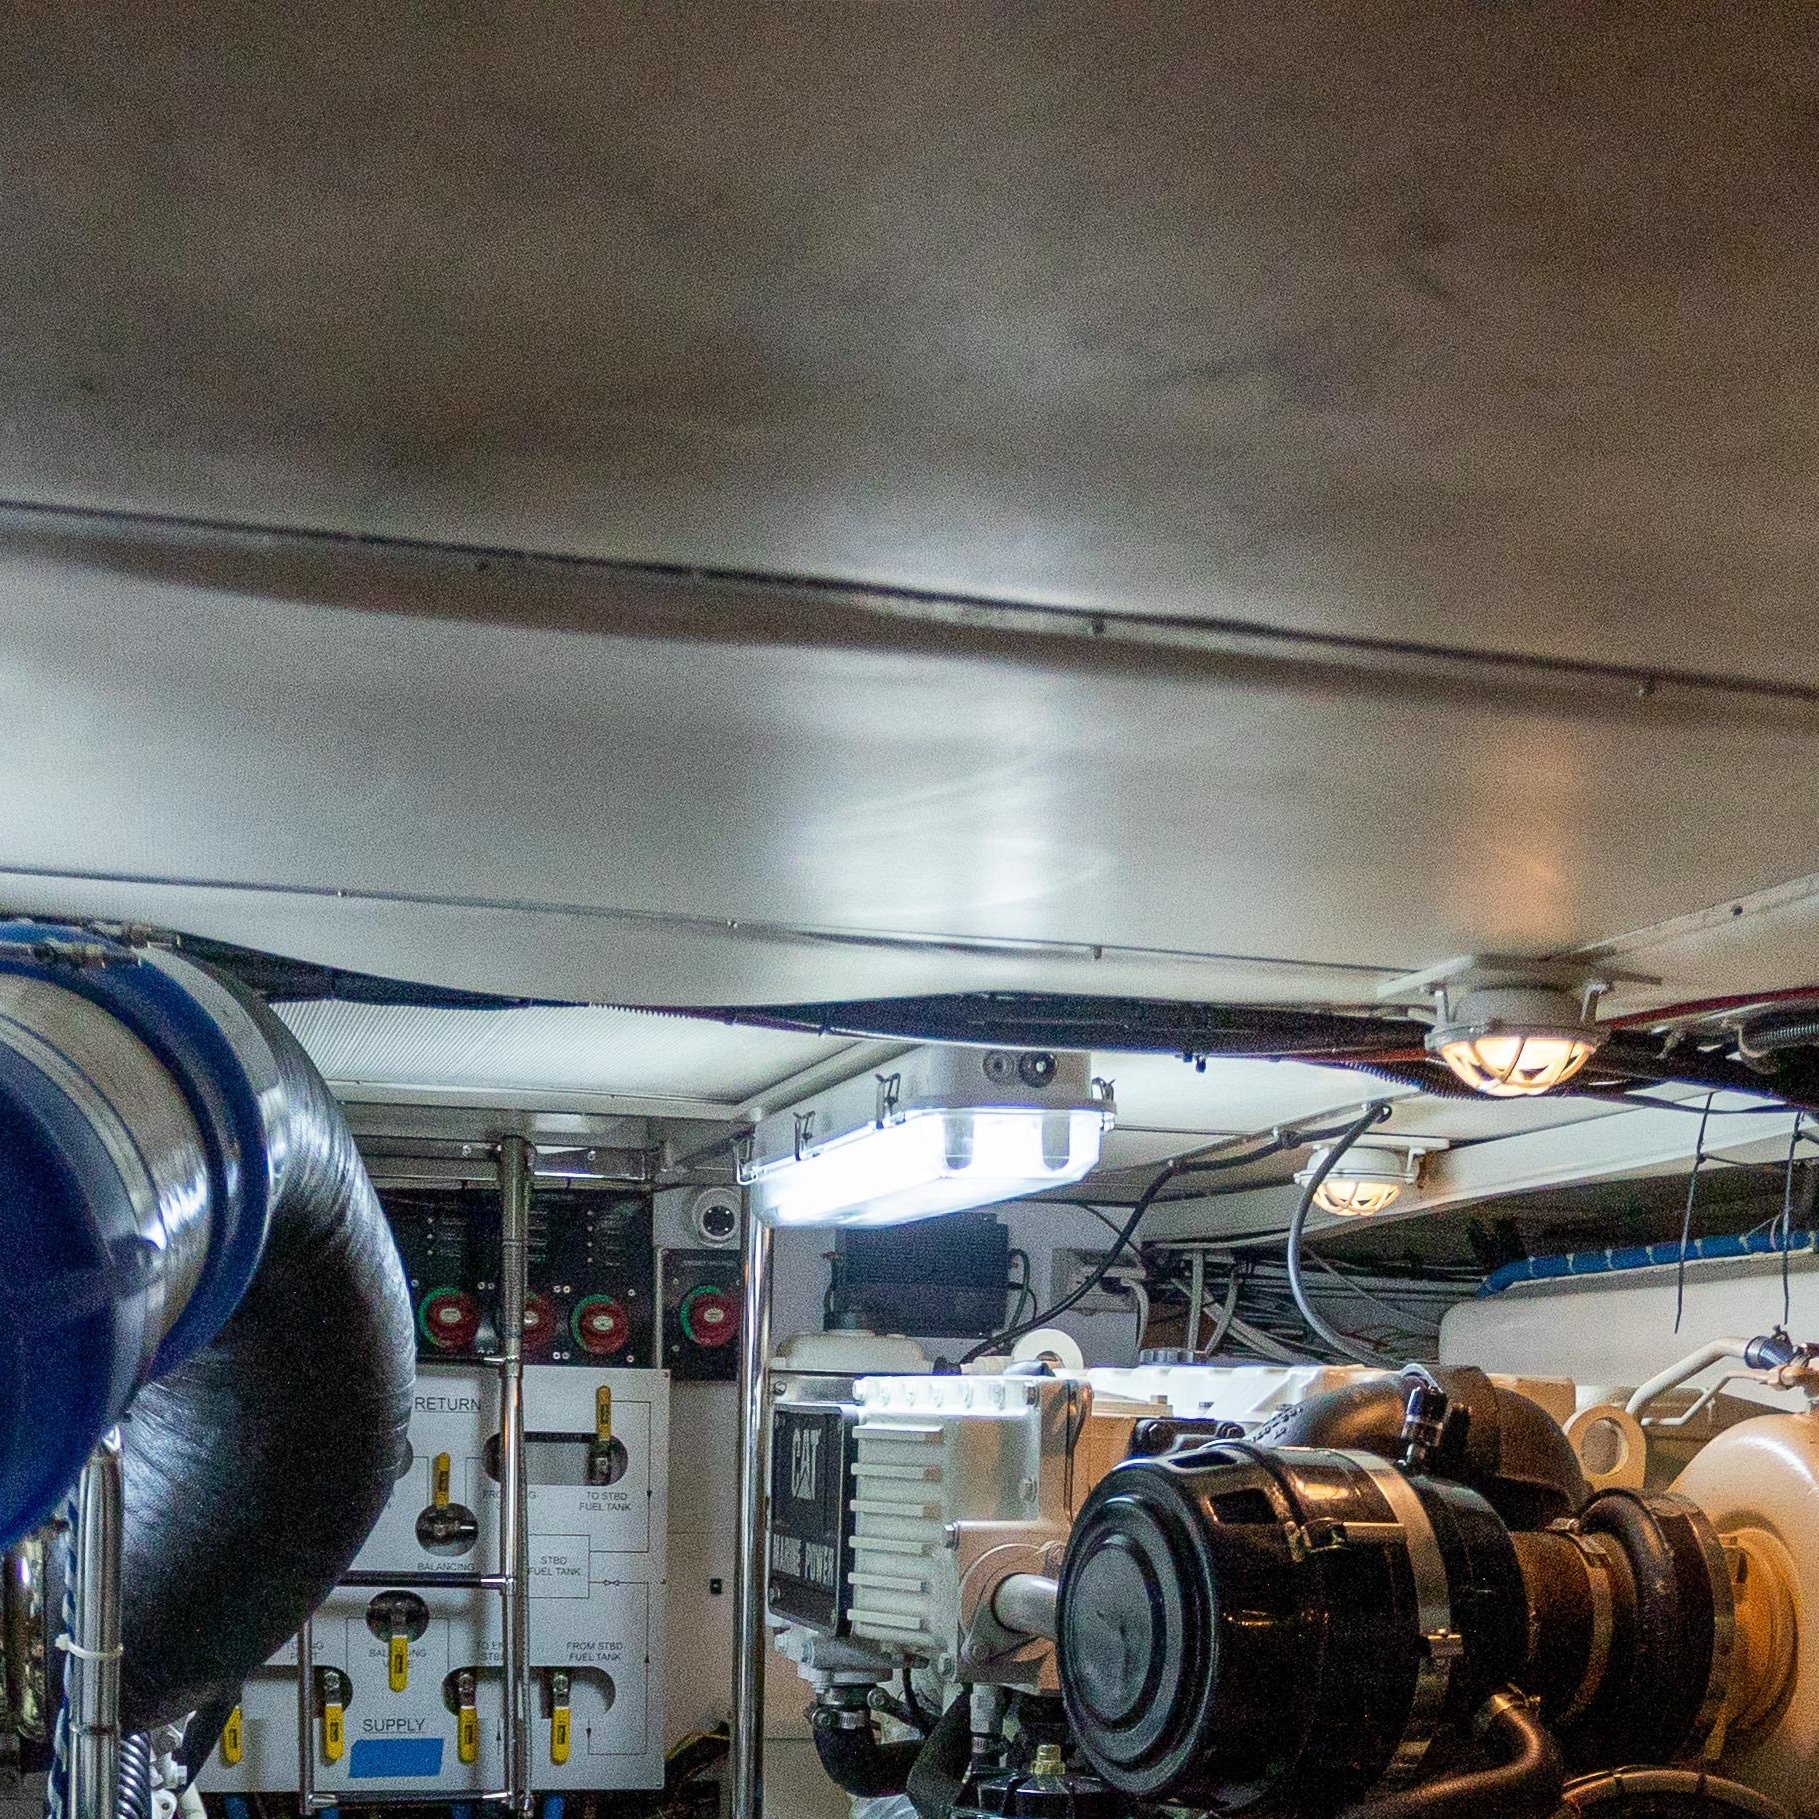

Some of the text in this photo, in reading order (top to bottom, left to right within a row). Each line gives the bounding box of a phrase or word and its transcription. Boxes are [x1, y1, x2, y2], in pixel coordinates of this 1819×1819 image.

[414, 1396, 482, 1411] RETURN
[791, 1427, 822, 1500] CAT
[586, 1492, 628, 1501] TO STBD
[579, 1503, 632, 1512] FUEL TANK
[540, 1556, 567, 1565] STBD
[417, 1562, 476, 1572] BALANCING
[555, 1567, 581, 1576] TANK
[566, 1642, 623, 1651] FROM STBD
[569, 1653, 621, 1662] FUEL TANK
[362, 1717, 425, 1733] SUPPLY
